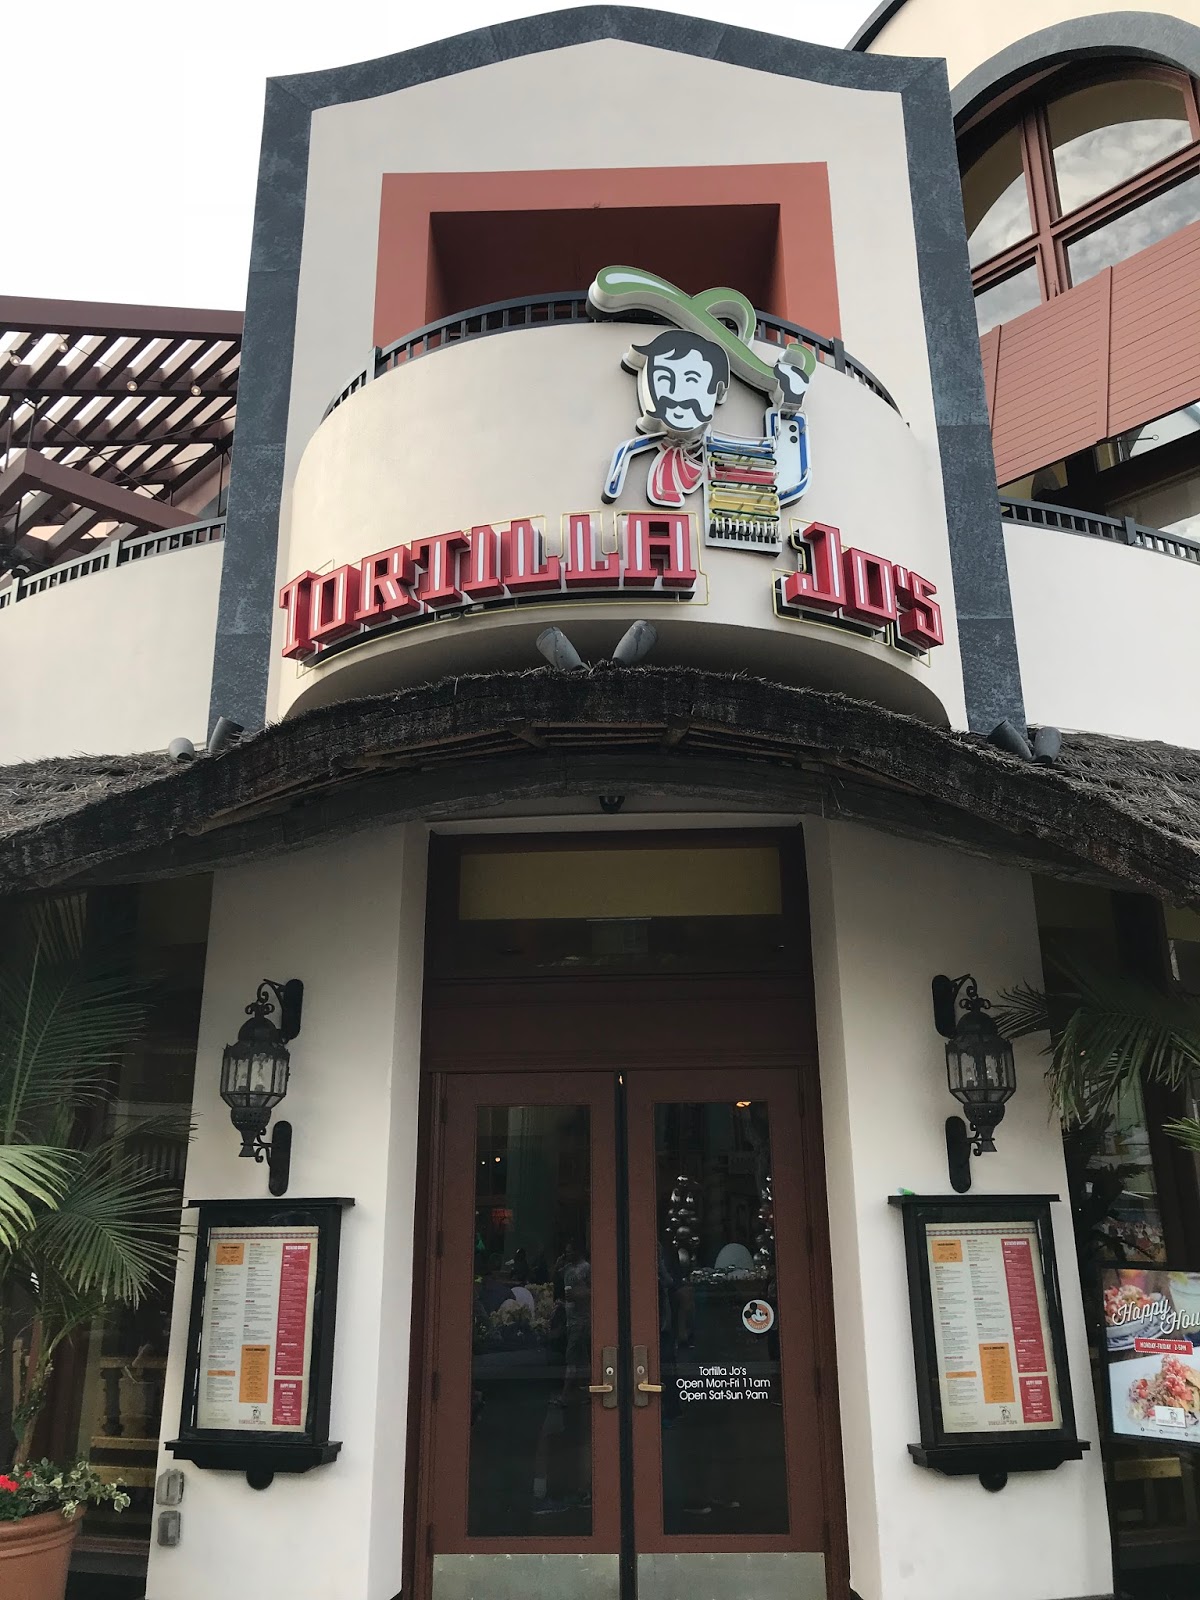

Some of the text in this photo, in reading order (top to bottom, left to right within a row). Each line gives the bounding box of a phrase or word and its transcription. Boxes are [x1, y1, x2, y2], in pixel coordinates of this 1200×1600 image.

[280, 513, 945, 657] TORTILLA JO'S
[1112, 1299, 1171, 1326] Happy
[699, 1366, 747, 1376] Tortilla Jo's
[676, 1377, 770, 1390] Open Mon-Fri 11am
[679, 1389, 768, 1402] Open Sat-Sun 9am
